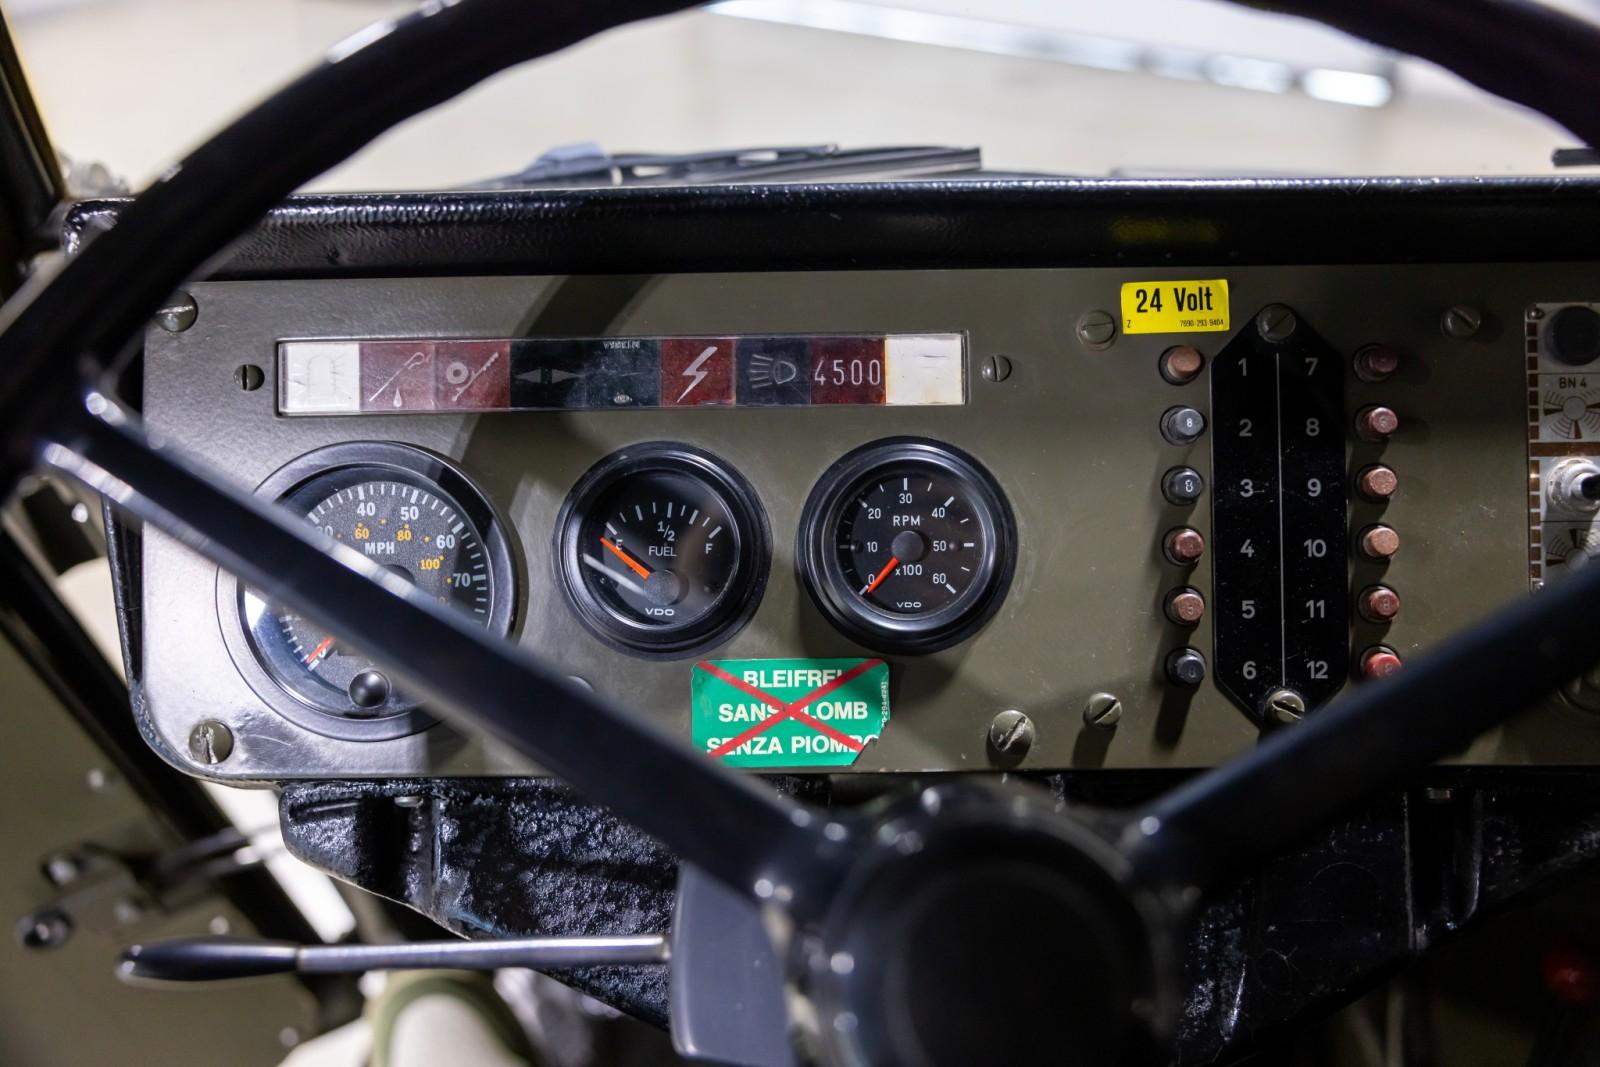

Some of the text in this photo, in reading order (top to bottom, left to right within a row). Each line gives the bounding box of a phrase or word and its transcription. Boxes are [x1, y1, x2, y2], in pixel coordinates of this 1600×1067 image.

[1136, 287, 1213, 313] 24 Volt
[813, 357, 883, 387] 4500
[1238, 358, 1247, 376] 1
[1305, 358, 1319, 376] 7
[1559, 376, 1587, 389] BN 4
[1186, 417, 1193, 428] 8
[1239, 419, 1253, 436] 2
[1305, 418, 1320, 436] 8
[1239, 479, 1253, 497] 3
[1307, 479, 1321, 497] 9
[899, 493, 913, 504] 30
[356, 502, 376, 517] 40
[400, 506, 419, 521] 50
[867, 507, 881, 519] 20
[931, 507, 946, 518] 40
[892, 515, 921, 526] RPM
[354, 528, 370, 540] 60
[396, 530, 412, 541] 80
[657, 520, 675, 542] 1/2
[364, 542, 395, 555] MPH
[436, 533, 456, 550] 60
[615, 539, 623, 551] E
[705, 543, 713, 554] F
[866, 541, 878, 552] 10
[932, 541, 947, 552] 50
[1240, 540, 1255, 557] 4
[1303, 540, 1327, 557] 10
[648, 545, 677, 557] FUEL
[420, 558, 440, 571] 100
[895, 564, 923, 576] x100
[452, 573, 471, 588] 70
[868, 574, 875, 585] 0
[932, 573, 946, 585] 60
[645, 607, 675, 616] VDO
[1242, 601, 1255, 618] 5
[1305, 600, 1325, 618] 11
[1242, 661, 1256, 679] 6
[1306, 661, 1328, 679] 12
[743, 669, 843, 688] BLEIFRE
[789, 701, 868, 721] LOMB
